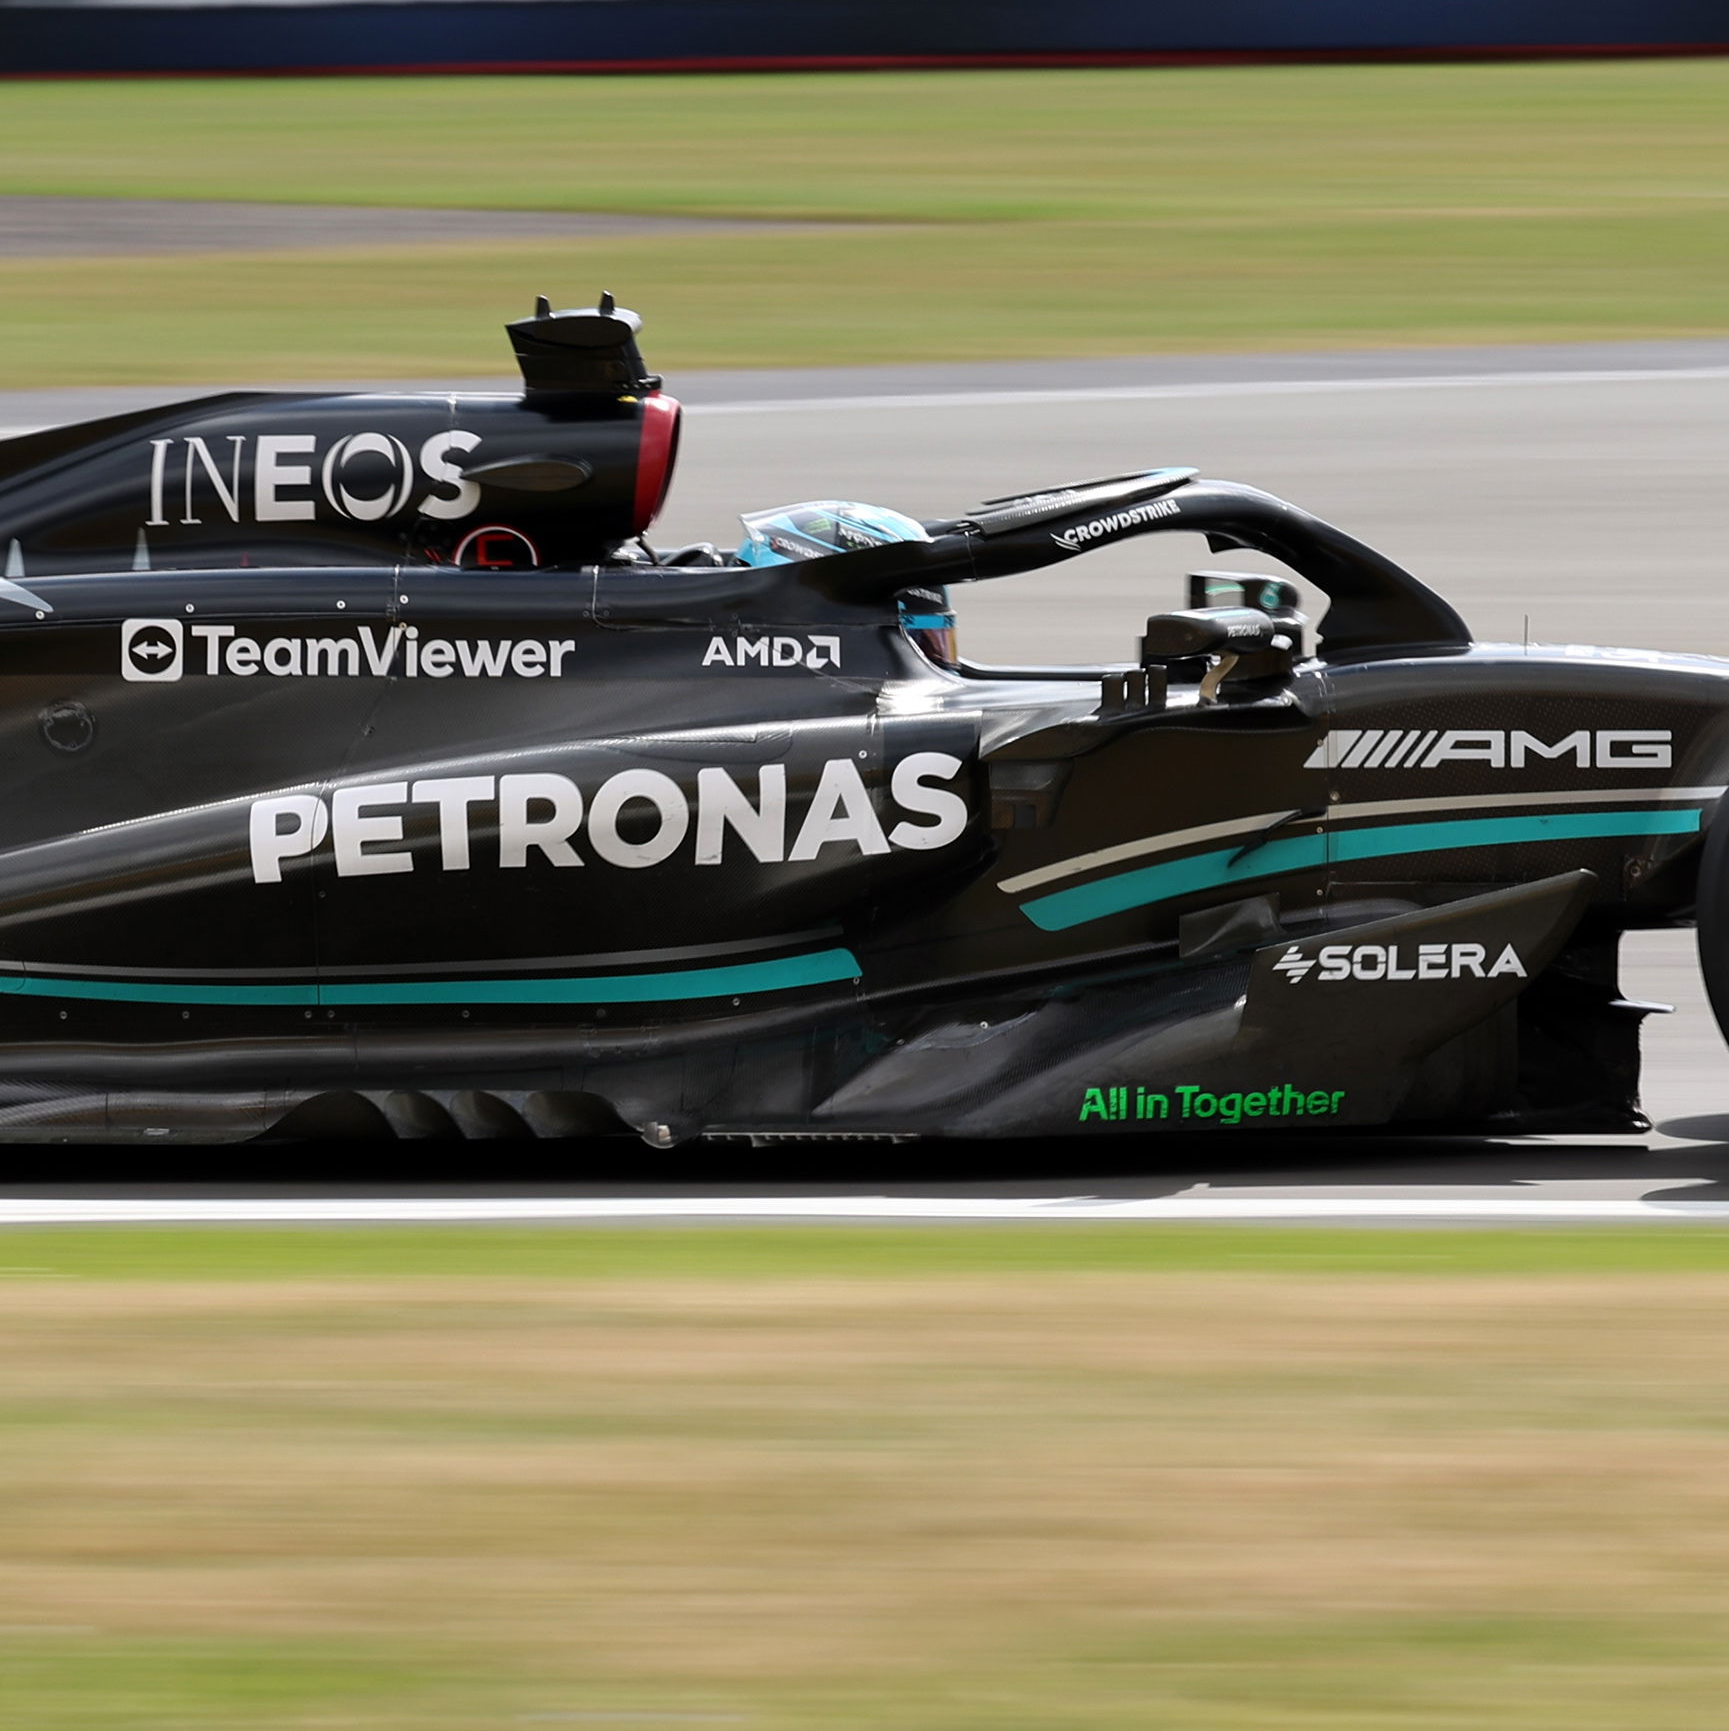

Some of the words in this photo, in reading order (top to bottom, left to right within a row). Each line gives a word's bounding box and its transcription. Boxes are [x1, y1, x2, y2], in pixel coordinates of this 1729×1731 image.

[145, 429, 482, 527] INEOS
[1063, 498, 1182, 546] CROWDSTRIKE
[190, 624, 576, 679] TeamViewer
[701, 635, 804, 667] AMD
[1420, 729, 1673, 769] AMG
[248, 751, 969, 885] PETRONAS
[1317, 942, 1529, 982] SOLERA
[1078, 1085, 1128, 1121] All
[1135, 1085, 1170, 1120] in
[1174, 1083, 1346, 1125] Together
